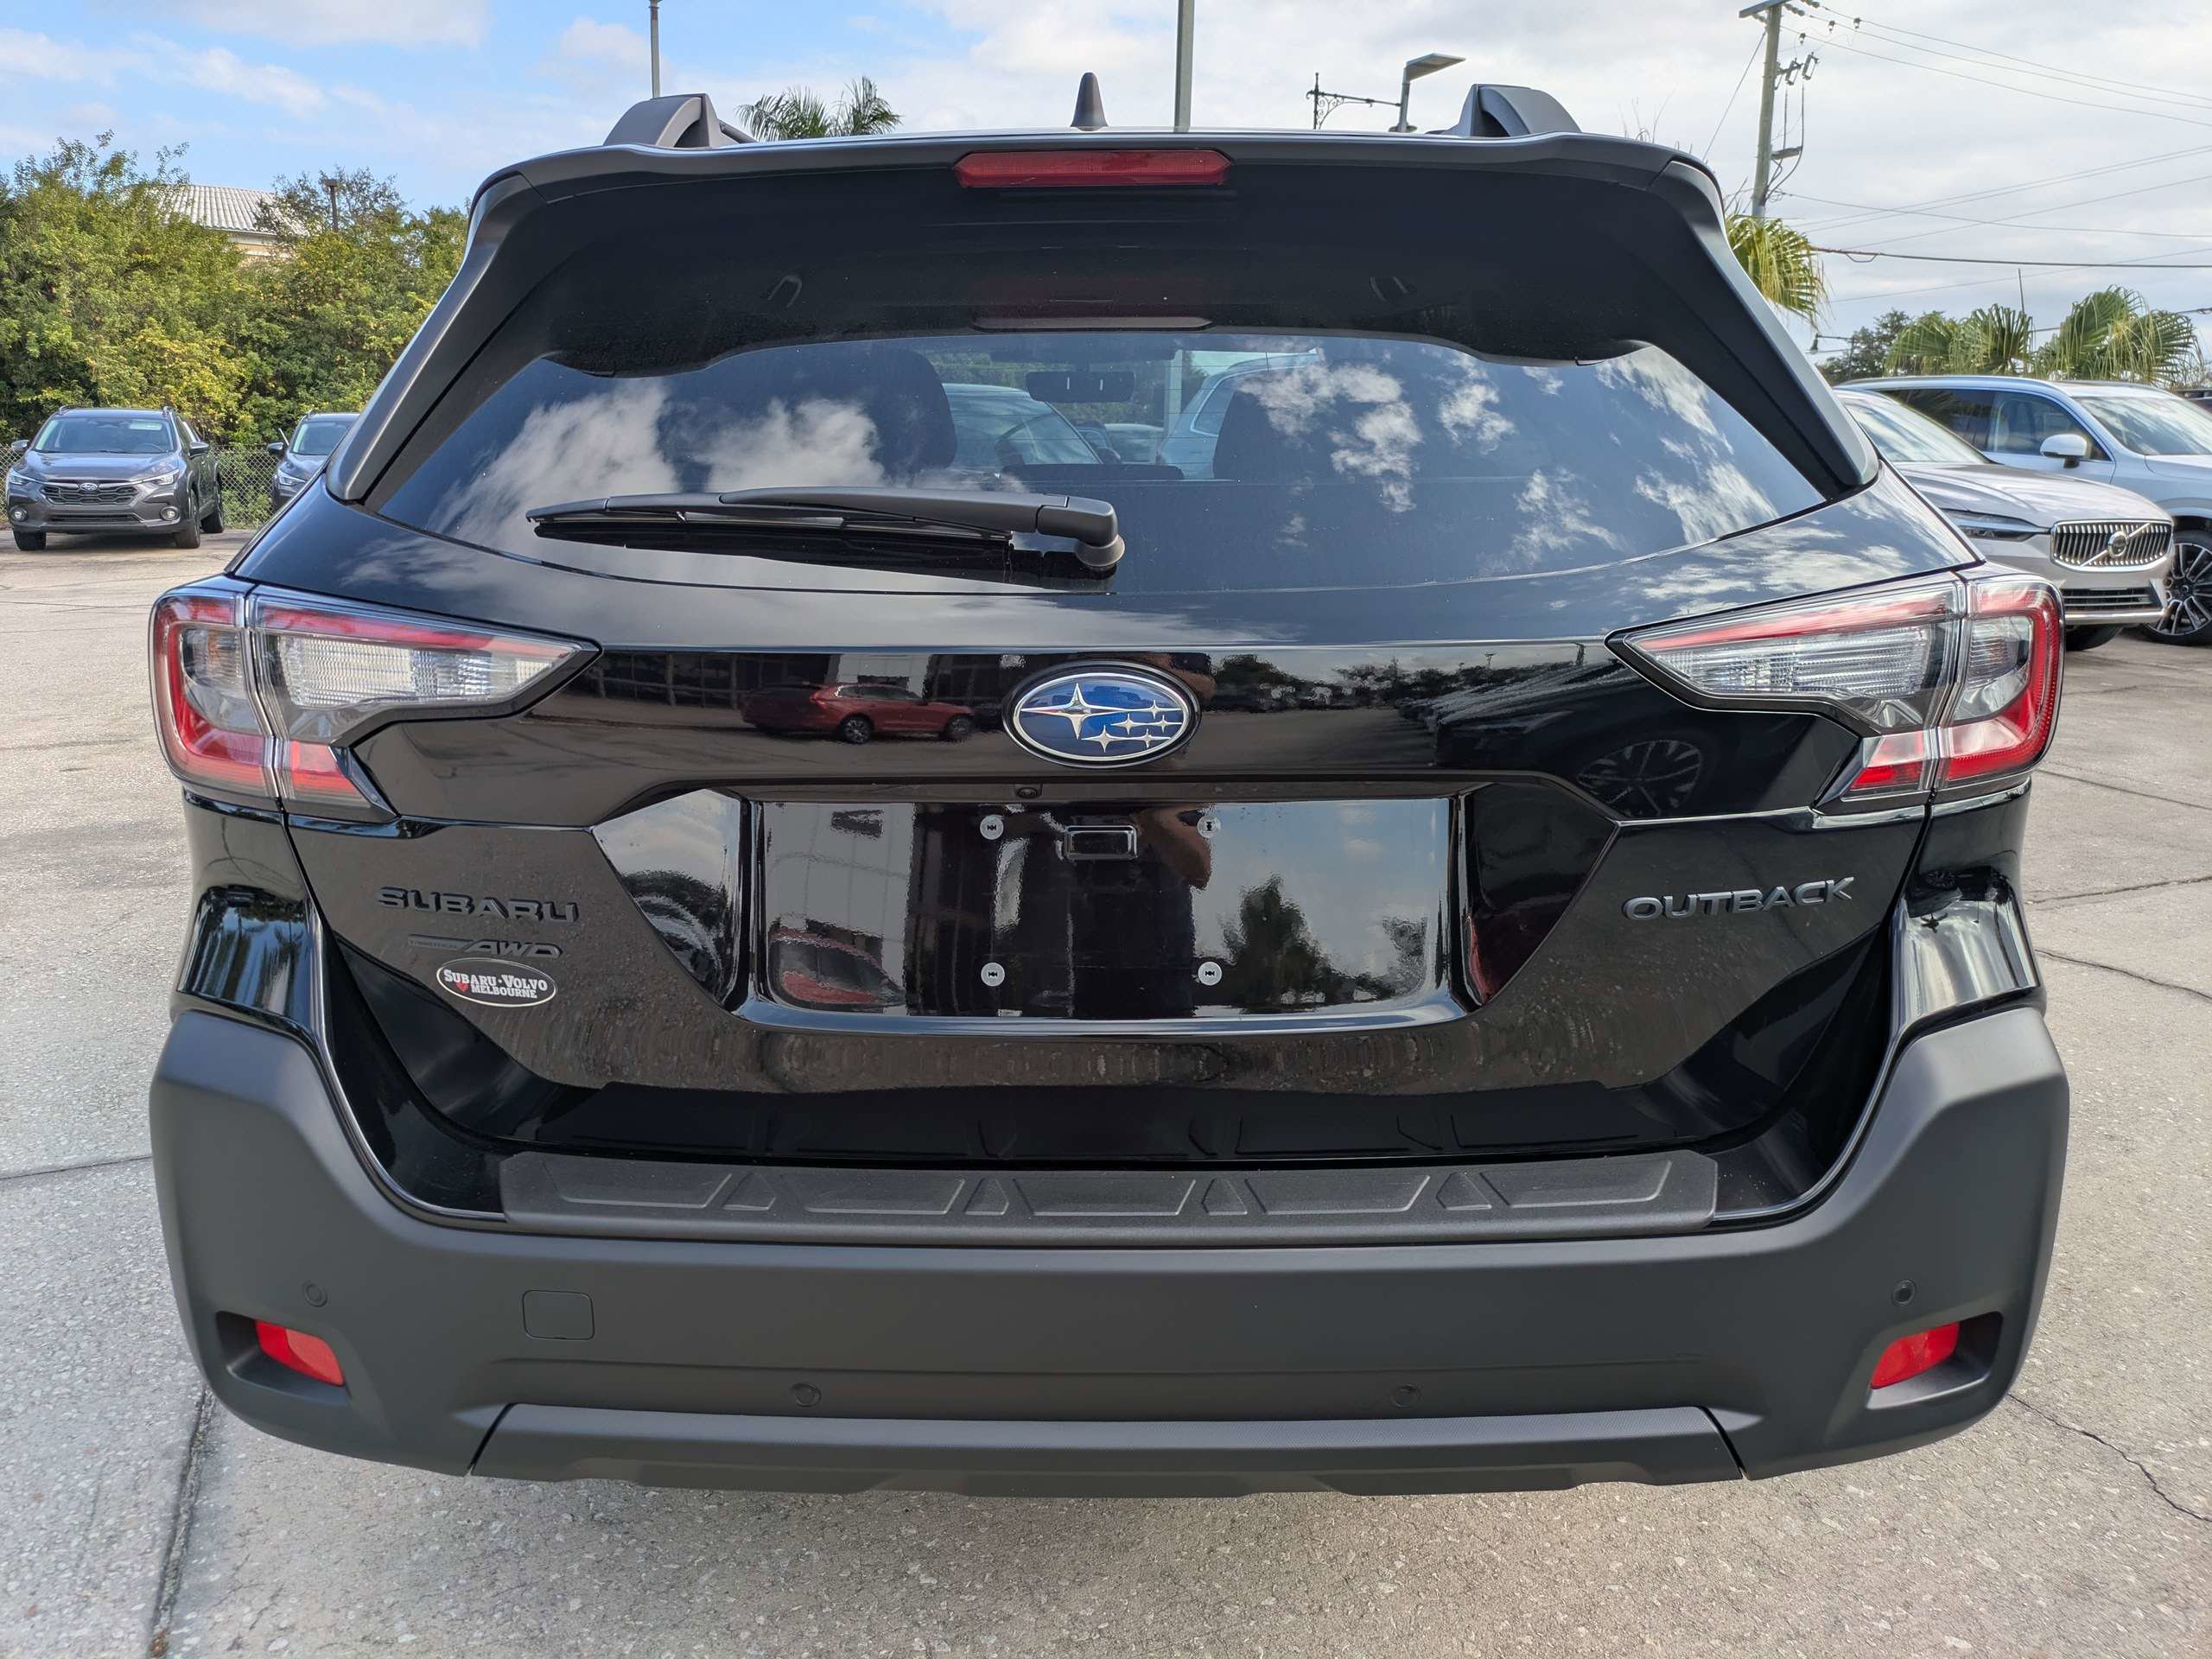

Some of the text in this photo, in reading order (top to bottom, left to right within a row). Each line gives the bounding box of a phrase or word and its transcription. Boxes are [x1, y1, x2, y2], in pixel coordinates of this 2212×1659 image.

[378, 887, 579, 923] SUBARU
[1622, 876, 1854, 920] OUTBACK
[465, 939, 563, 957] AWD
[471, 982, 537, 998] MELBOURNE
